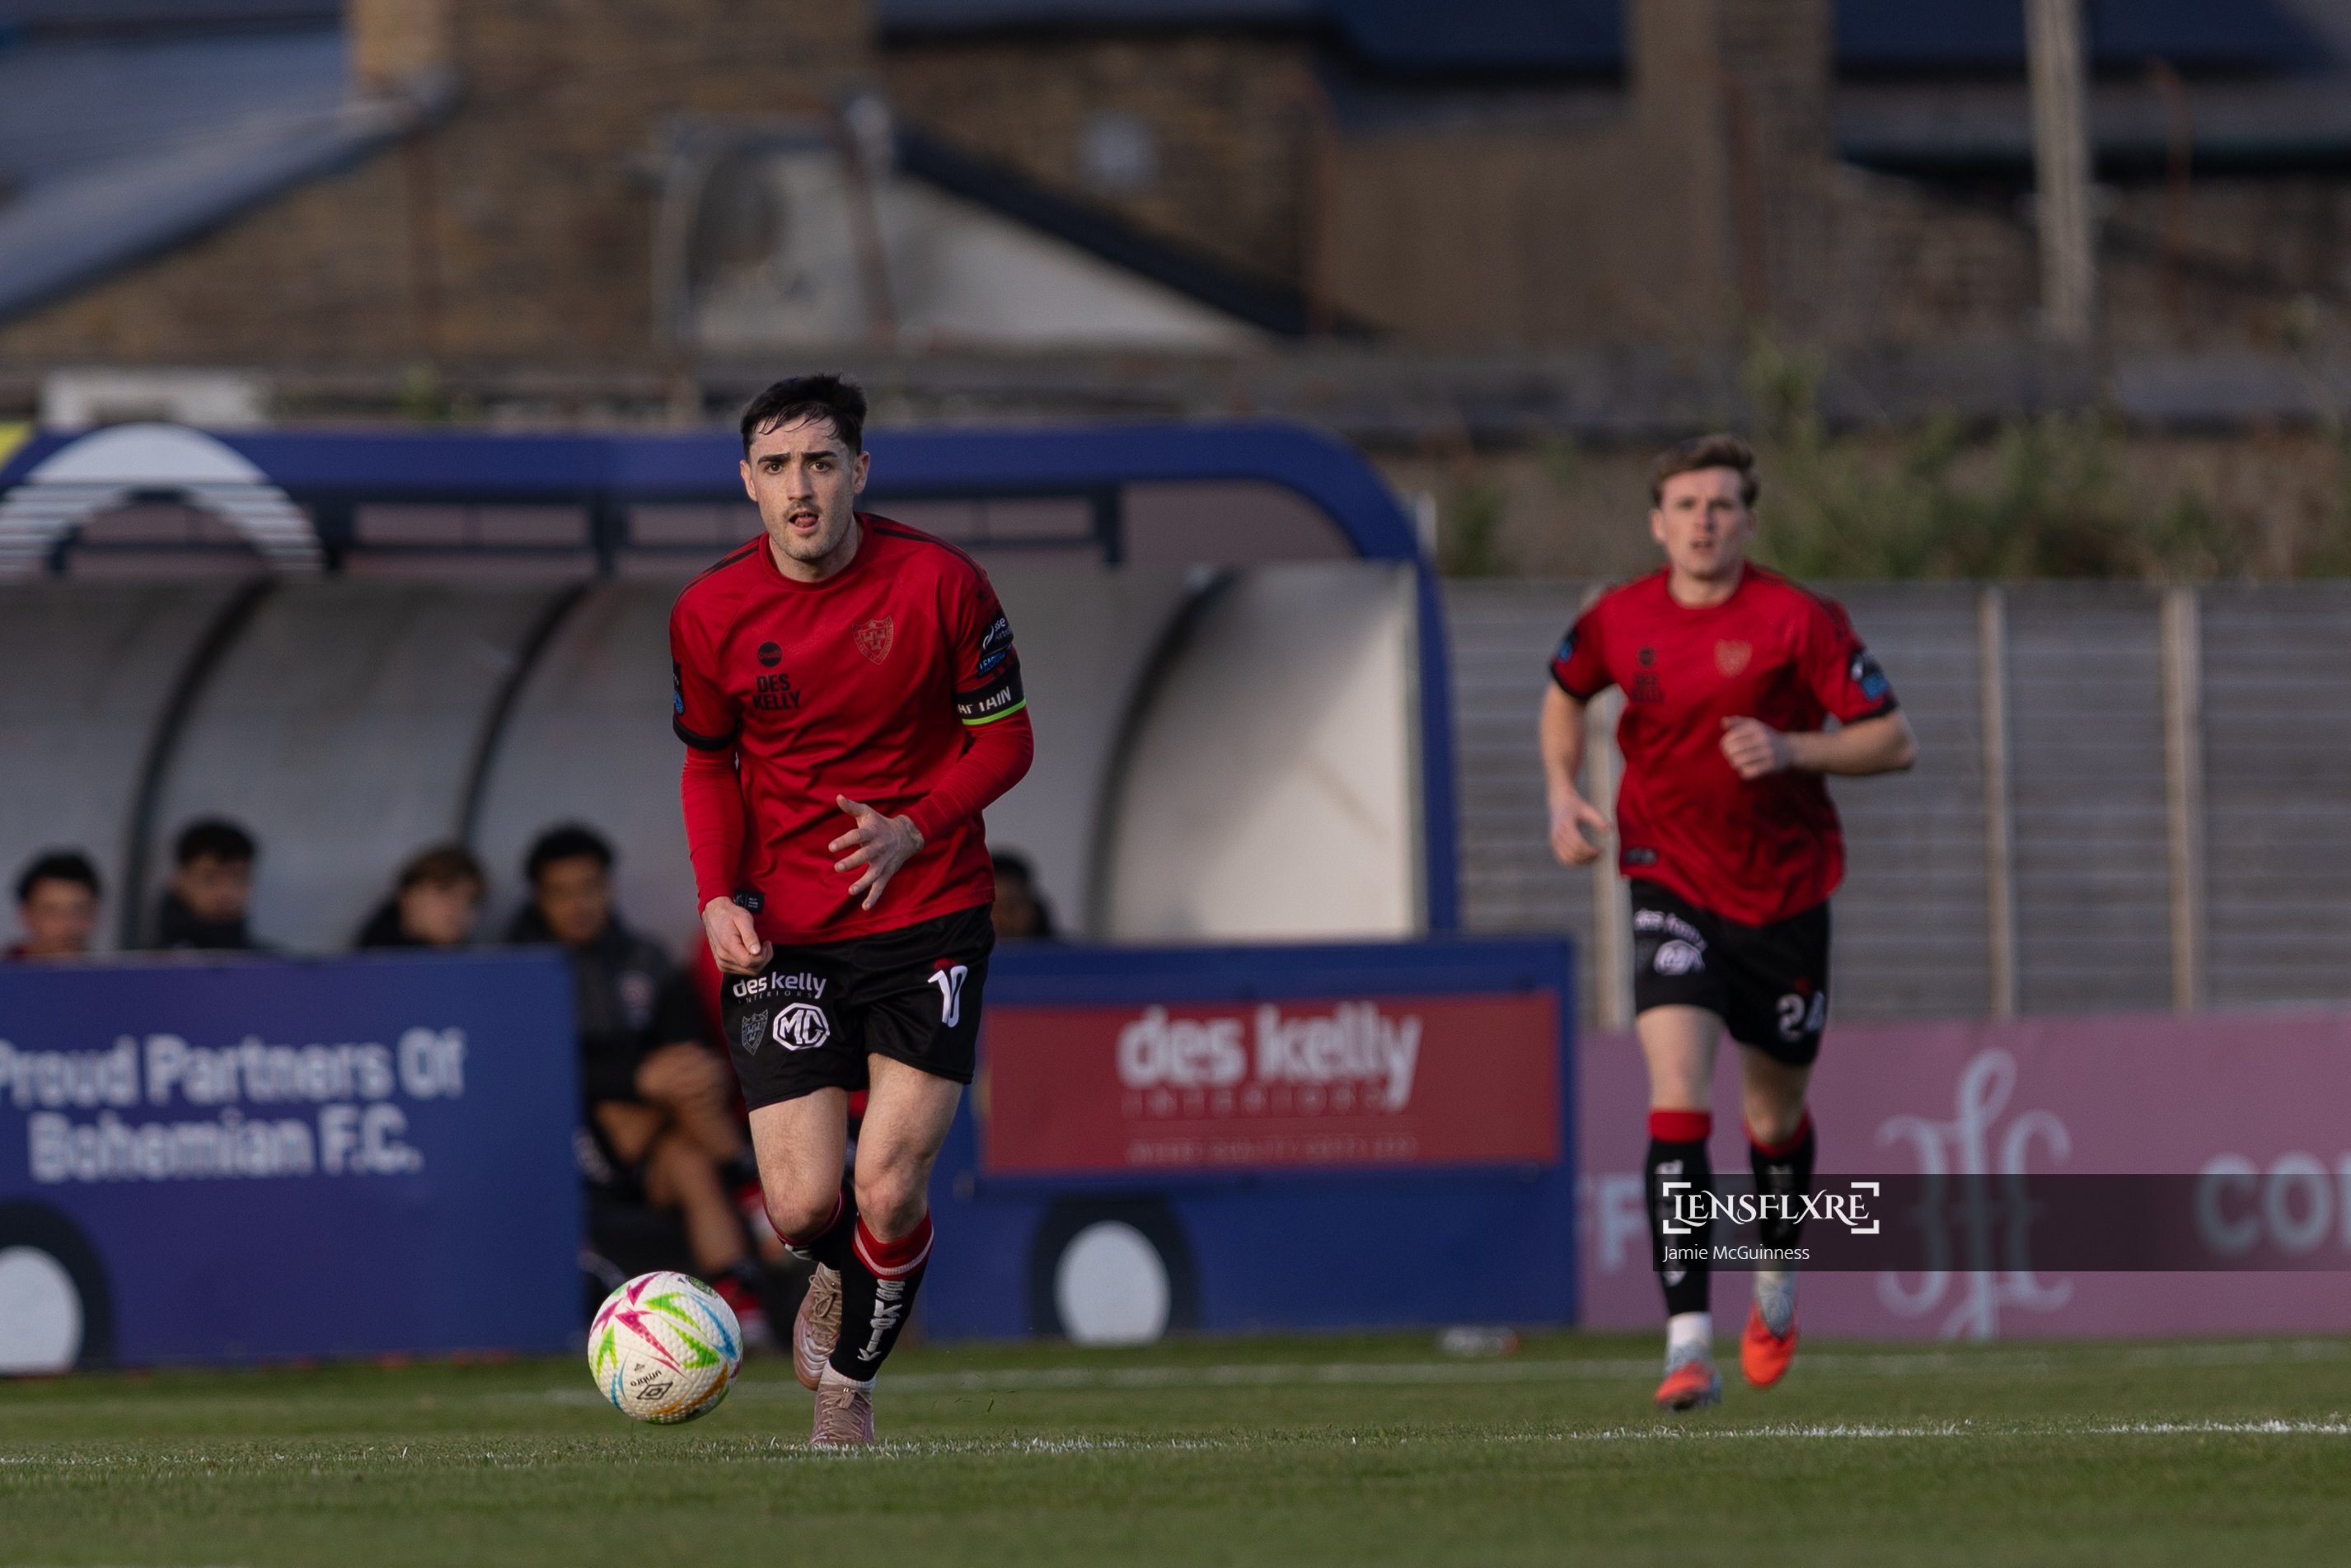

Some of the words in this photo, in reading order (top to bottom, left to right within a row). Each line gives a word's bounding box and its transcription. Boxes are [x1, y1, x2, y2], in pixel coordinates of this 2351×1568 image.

[752, 690, 800, 711] KELLY
[756, 672, 790, 693] DES
[733, 976, 768, 997] des
[771, 971, 827, 999] kelly
[738, 990, 813, 1004] INTERIORS
[927, 965, 968, 1027] 10
[776, 1006, 827, 1047] MG
[0, 1035, 140, 1109] Proud
[145, 1032, 394, 1105] Partners
[397, 1027, 466, 1100] Of
[1116, 1004, 1248, 1089] des
[1253, 999, 1422, 1112] kelly
[28, 1106, 316, 1184] Bohemian
[318, 1102, 424, 1177] F.C.
[2194, 1152, 2351, 1254] CO
